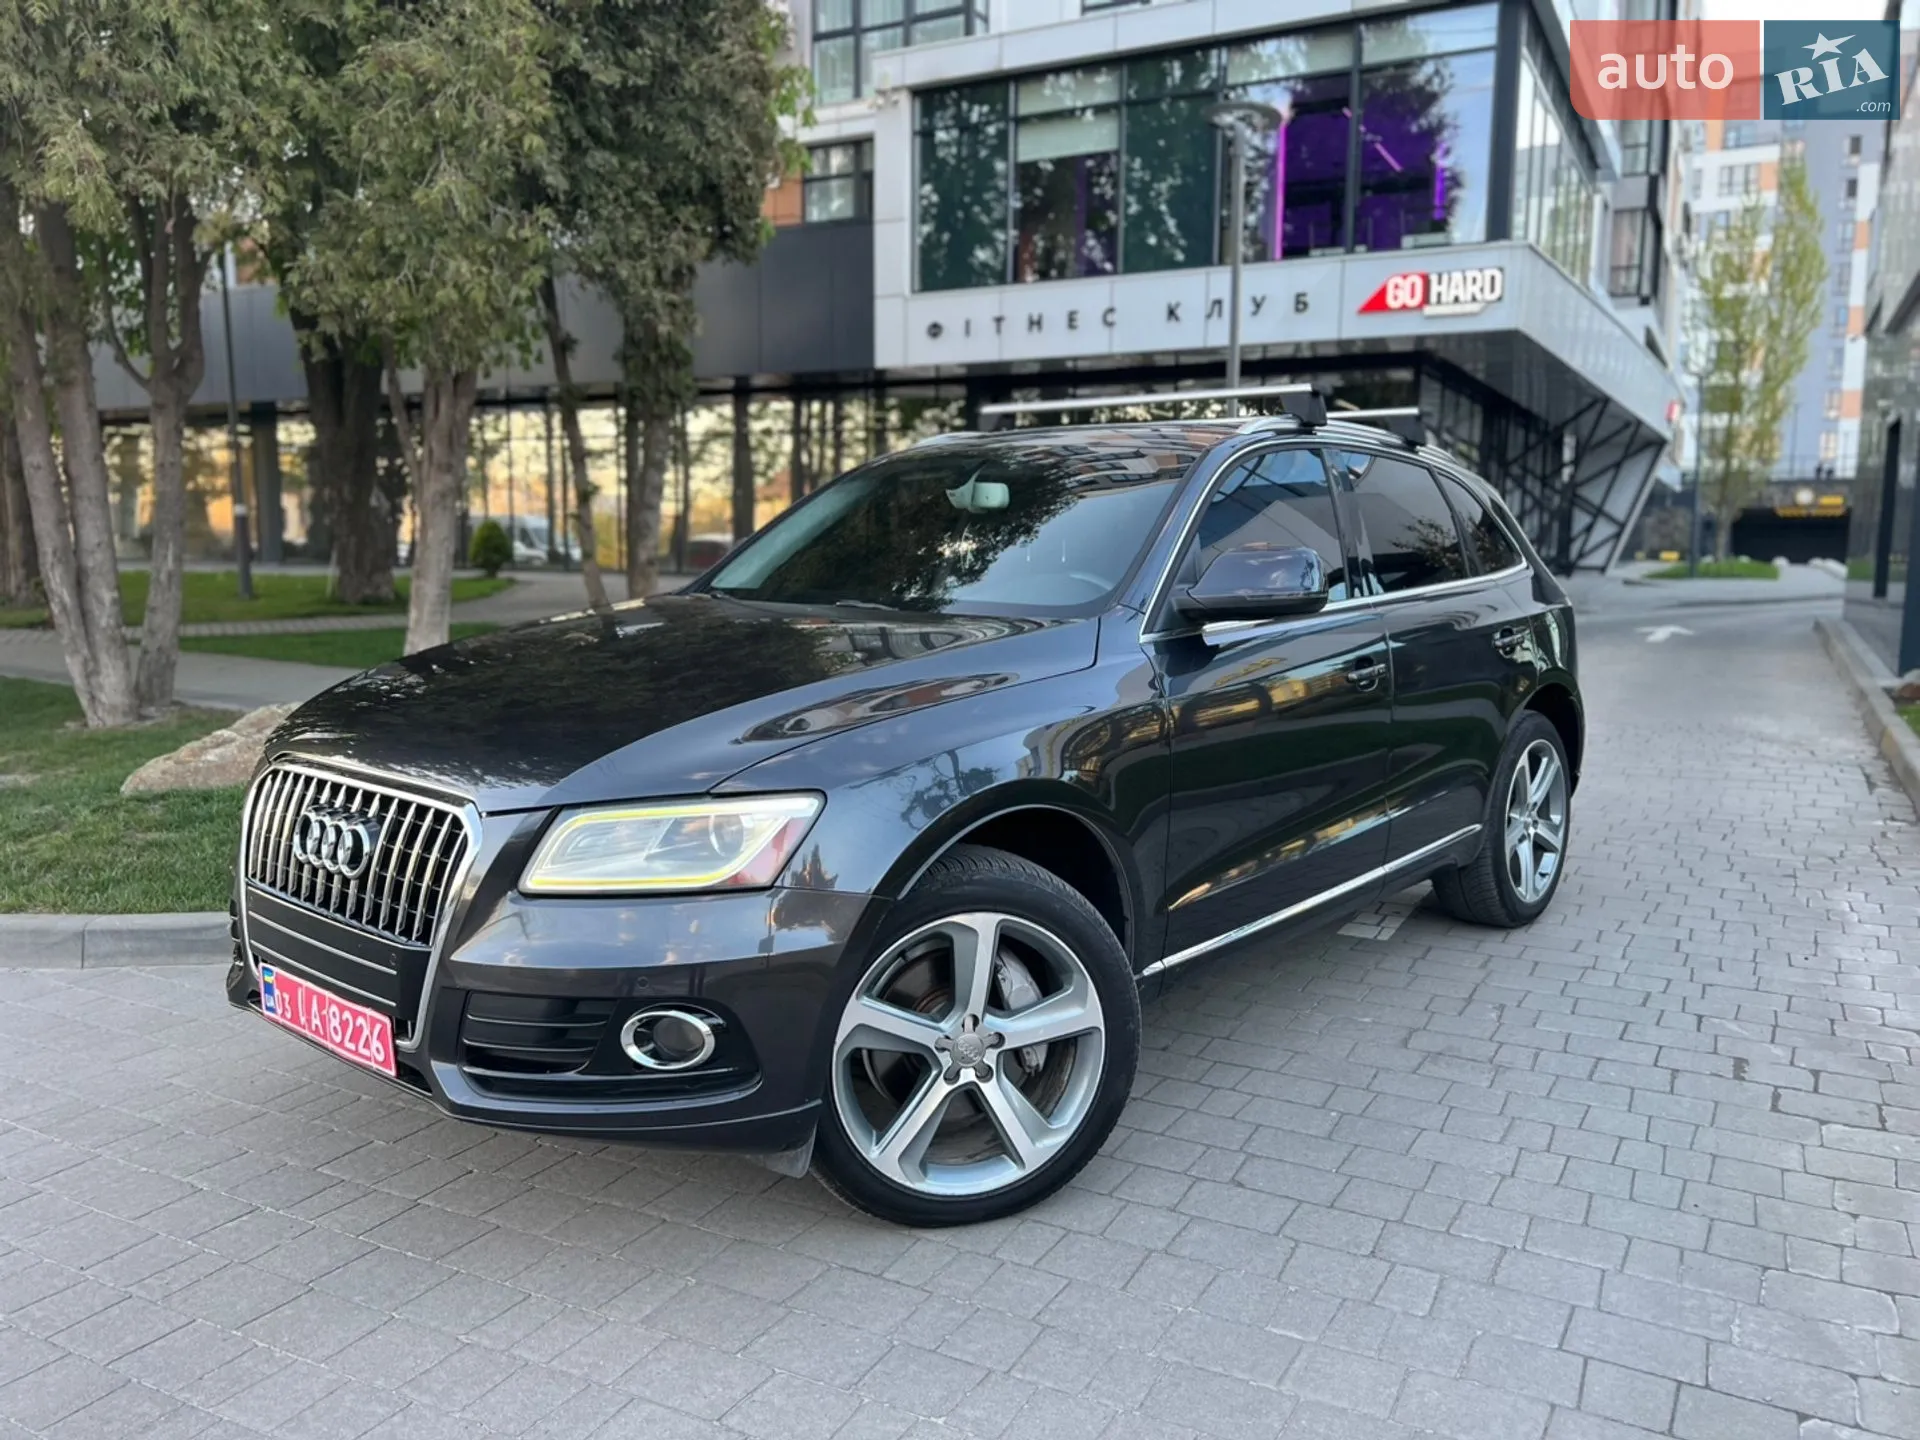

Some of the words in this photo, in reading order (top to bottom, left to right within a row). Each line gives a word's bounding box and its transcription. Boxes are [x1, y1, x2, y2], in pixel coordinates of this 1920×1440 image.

[1385, 274, 1423, 309] GO
[1429, 267, 1503, 305] HARD
[926, 307, 1117, 339] ФІТНЕС
[1166, 292, 1309, 323] КЛУБ
